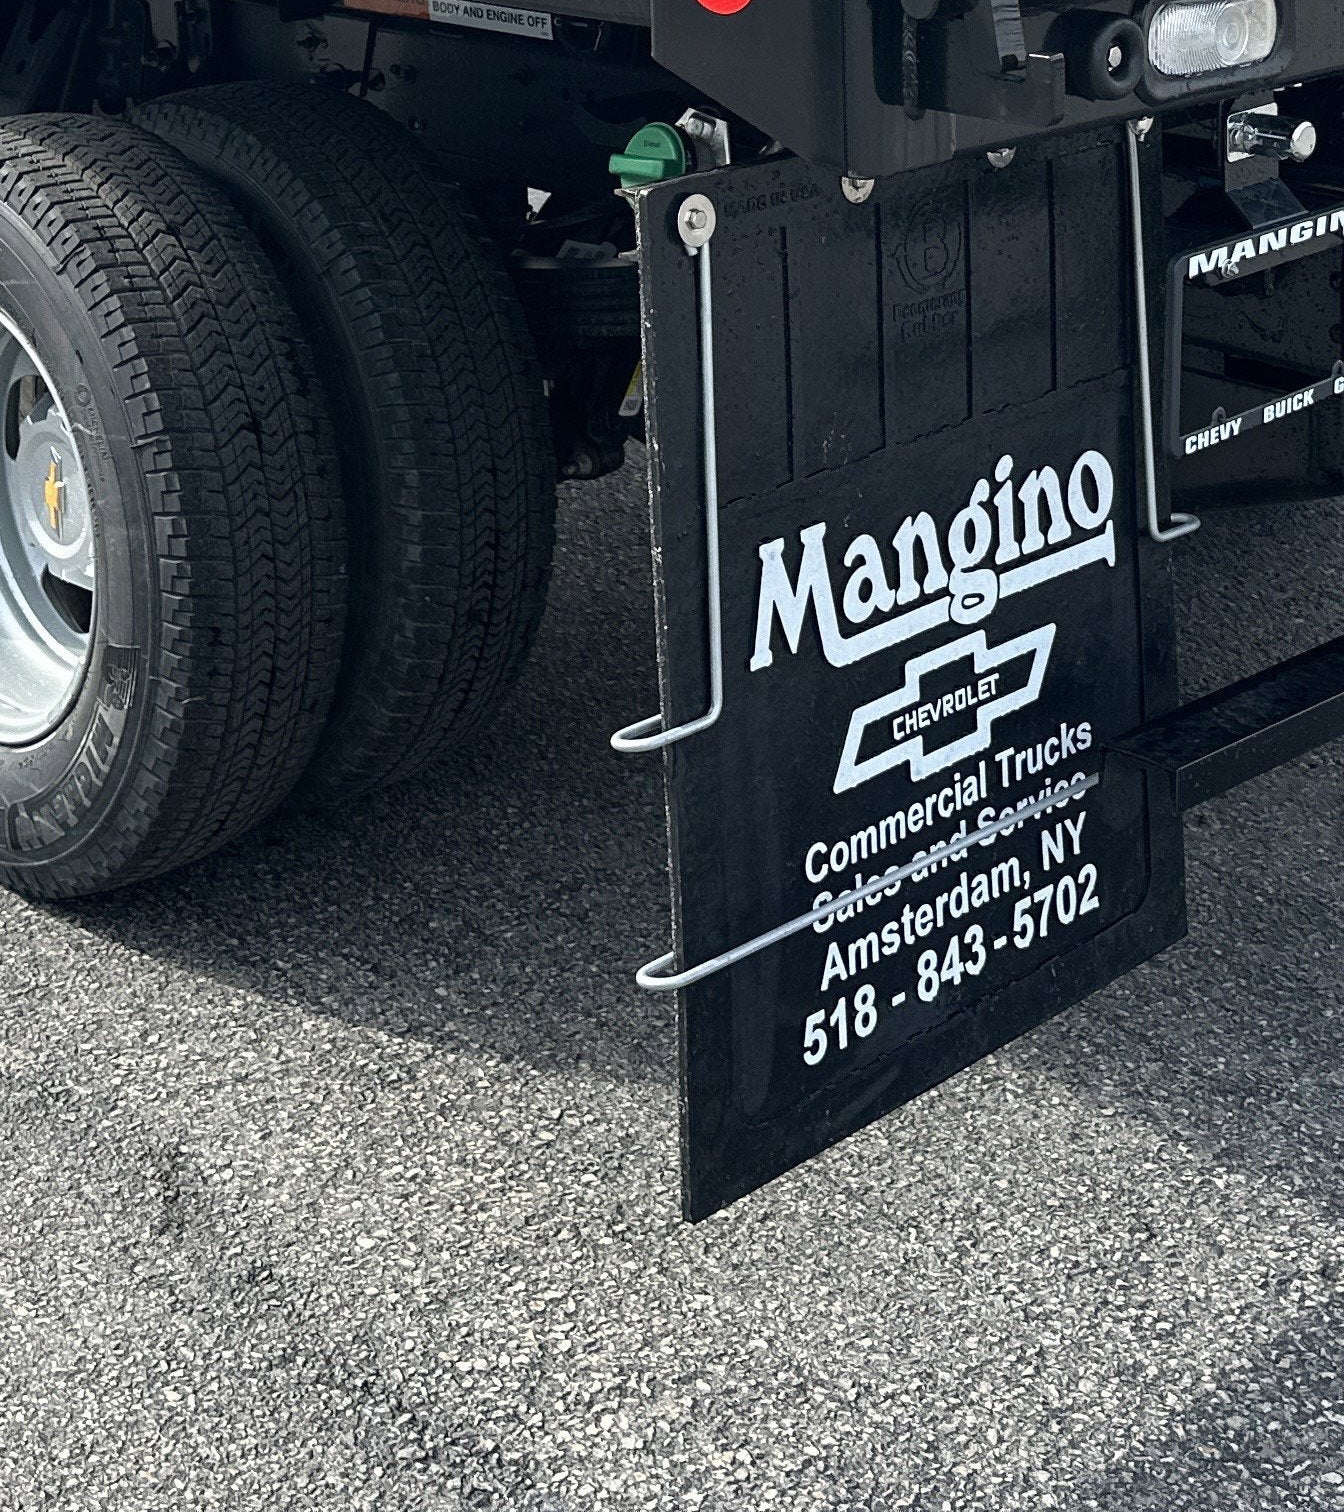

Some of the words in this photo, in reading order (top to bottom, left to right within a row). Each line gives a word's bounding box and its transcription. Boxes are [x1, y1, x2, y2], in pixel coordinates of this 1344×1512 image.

[432, 0, 460, 16] BODY
[462, 4, 484, 20] AND
[486, 8, 525, 26] ENGINE
[527, 14, 548, 30] OFF
[1185, 417, 1242, 456] CHEVY
[1263, 388, 1315, 424] BUICK
[749, 449, 1116, 672] Mangino
[14, 710, 116, 853] MICHELIN
[892, 673, 1000, 741] CHEVROLET
[804, 759, 988, 884] Commercial
[994, 718, 1093, 788] Trucks
[811, 864, 902, 934] Sales
[911, 819, 969, 883] and
[976, 771, 1087, 847] Service
[803, 983, 878, 1066] 518
[1012, 863, 1100, 949] 5702
[820, 856, 1031, 992] Amsterdam,
[1040, 810, 1087, 871] NY
